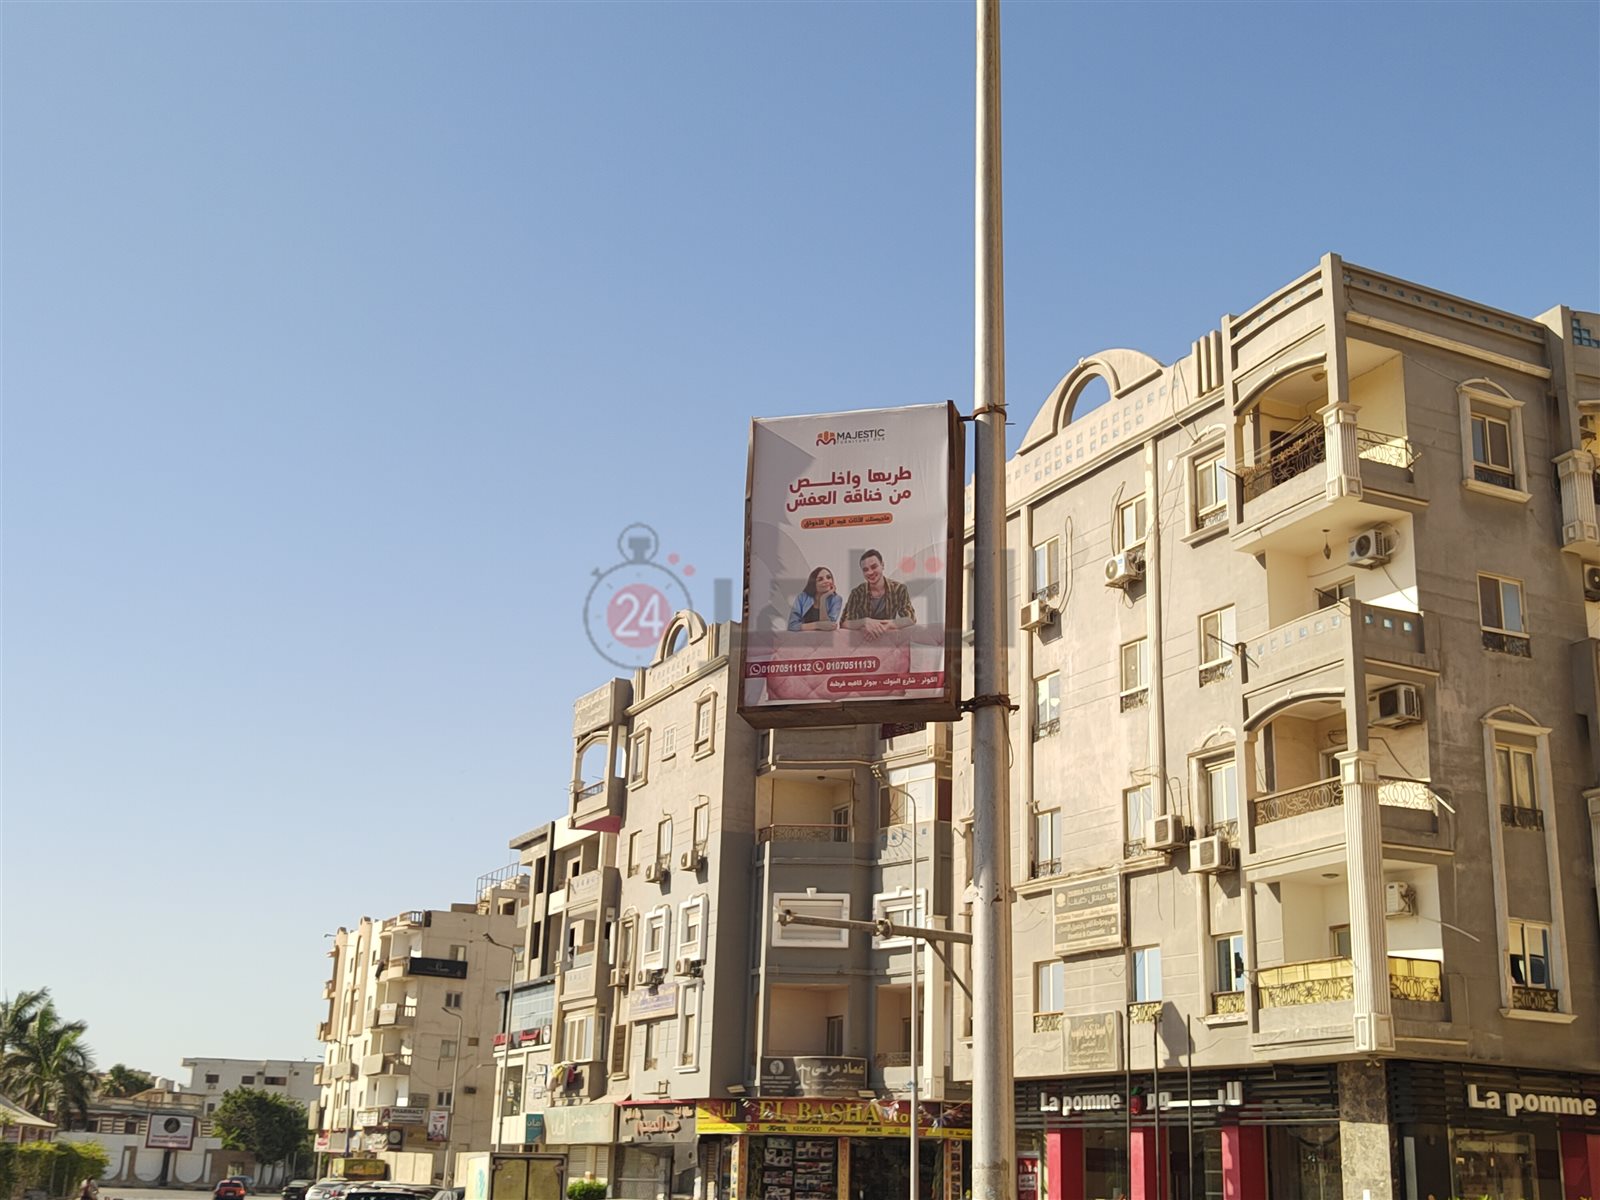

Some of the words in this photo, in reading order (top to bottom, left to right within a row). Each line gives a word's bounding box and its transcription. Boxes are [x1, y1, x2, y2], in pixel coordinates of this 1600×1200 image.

[837, 429, 885, 440] MAJESTIC
[868, 466, 912, 486] طريها
[786, 490, 837, 512] العفش
[843, 488, 882, 503] خناقة
[889, 489, 912, 505] من
[826, 660, 876, 671] 01070511131
[1040, 1092, 1059, 1111] La
[1062, 1093, 1120, 1116] pomme
[1467, 1084, 1500, 1109] La
[1505, 1092, 1597, 1117] pomme
[759, 1101, 790, 1121] EL
[798, 1101, 881, 1123] BASHA
[746, 1124, 760, 1132] 3M
